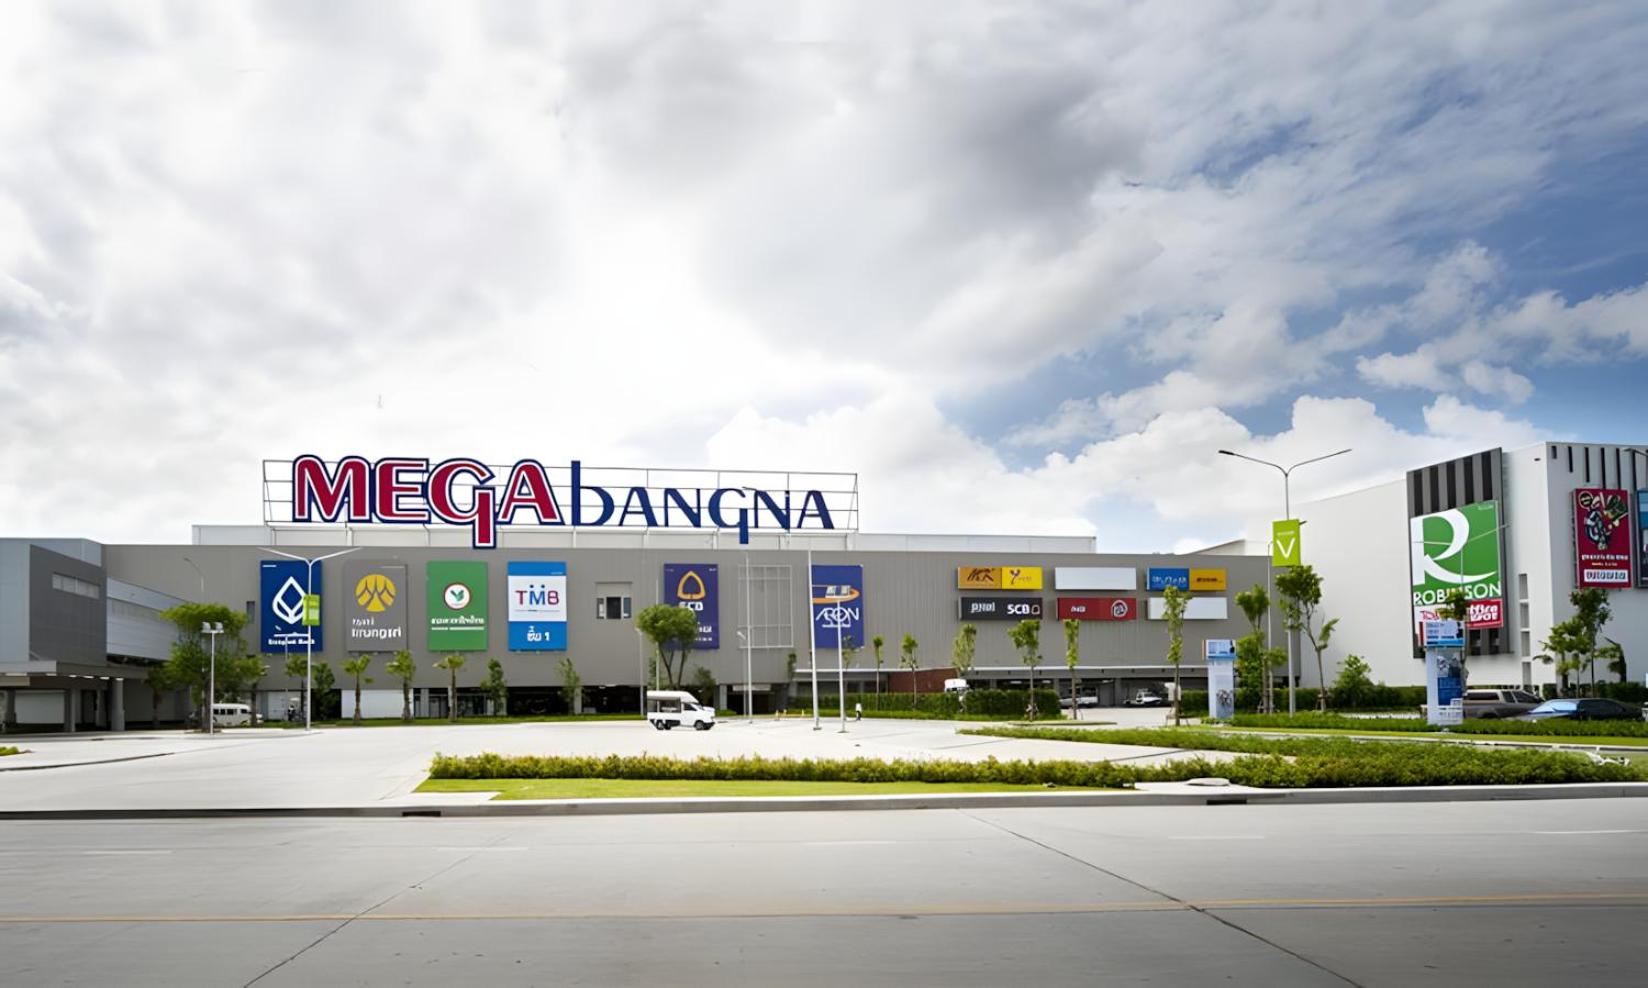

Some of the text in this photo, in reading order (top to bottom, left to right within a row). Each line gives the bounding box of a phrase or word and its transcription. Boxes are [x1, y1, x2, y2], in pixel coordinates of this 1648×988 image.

[292, 454, 565, 549] MEGA
[515, 584, 560, 605] TMB
[1413, 581, 1502, 606] ROBSON
